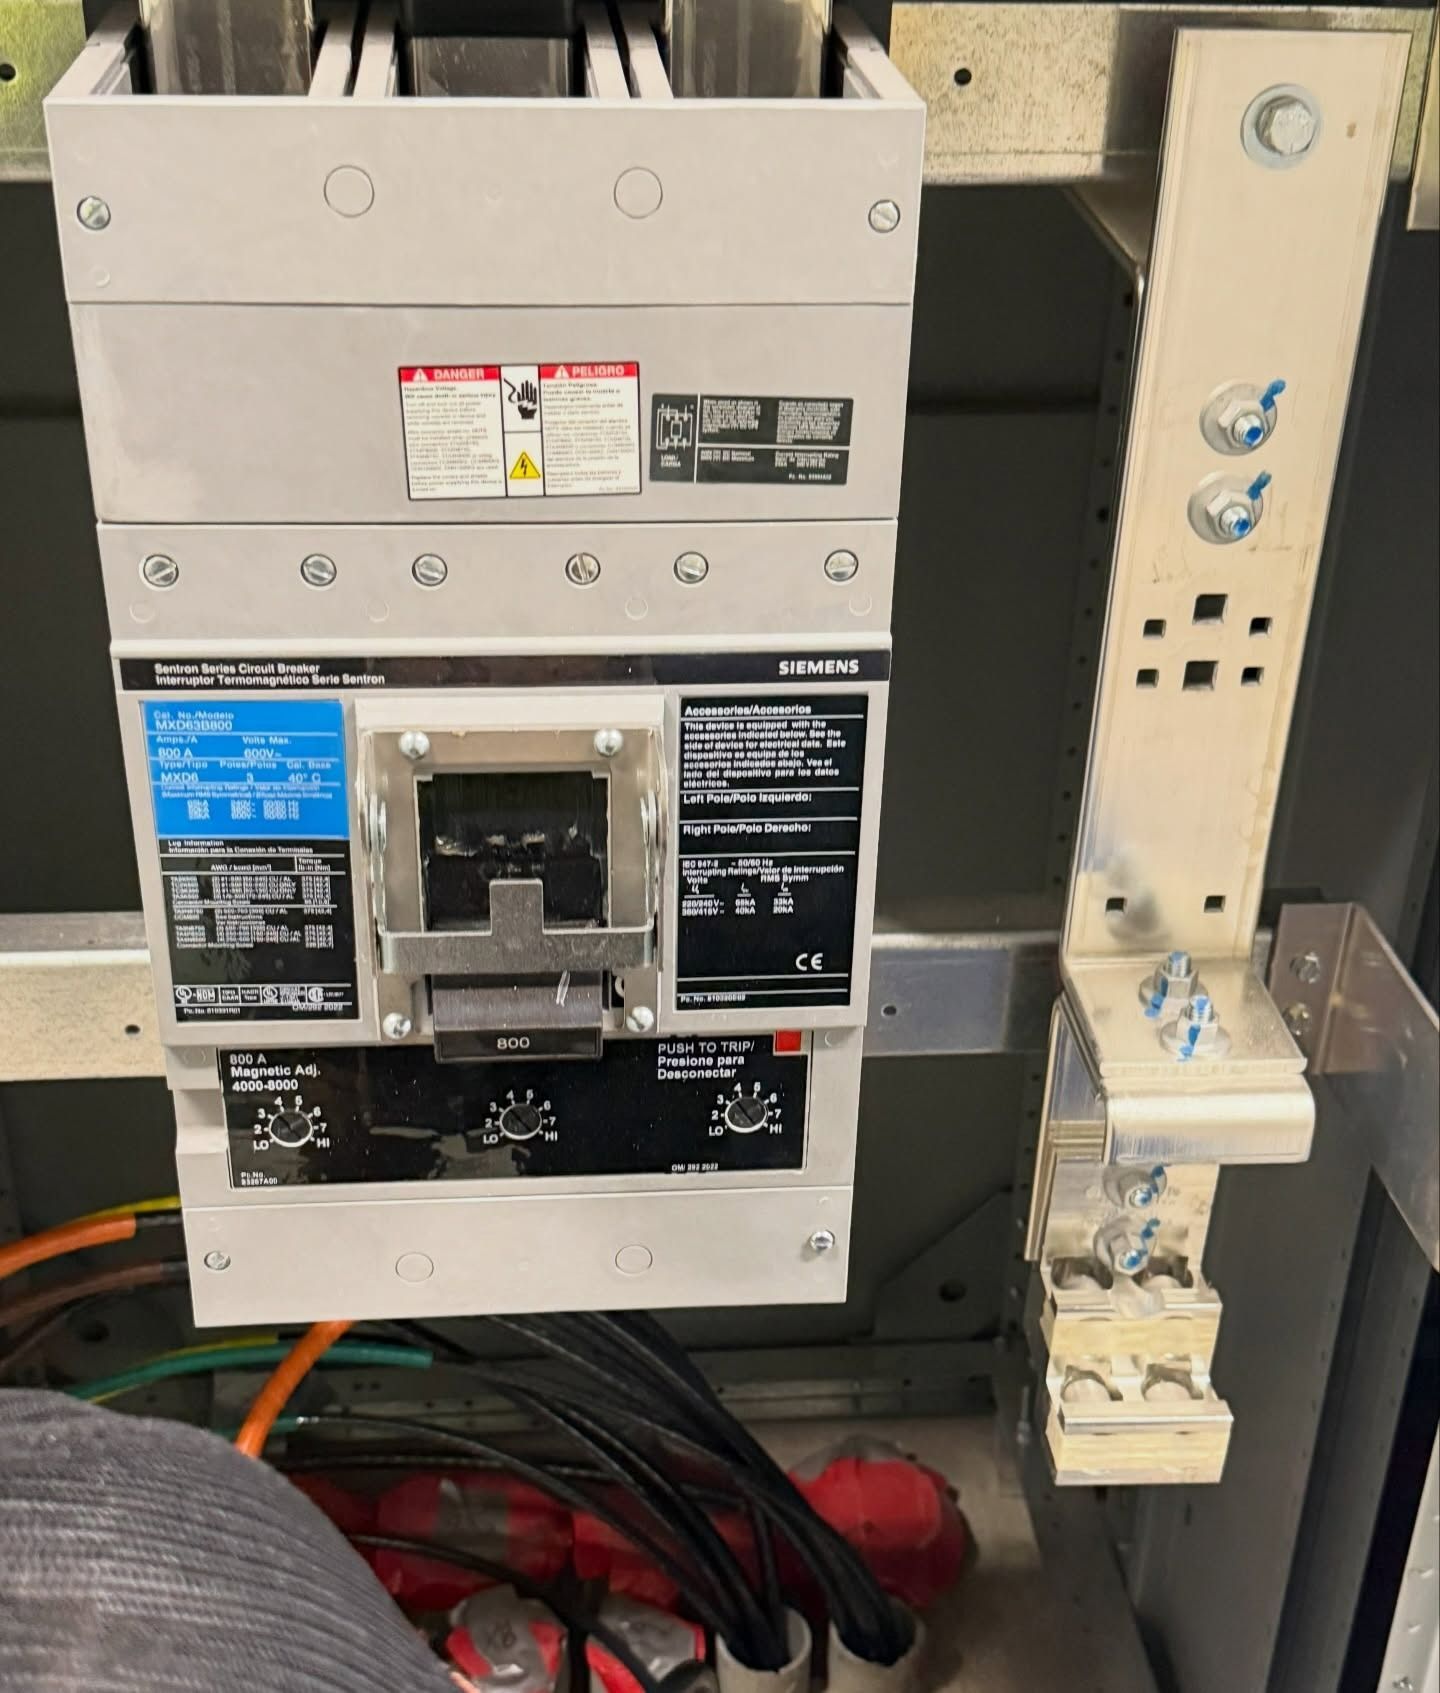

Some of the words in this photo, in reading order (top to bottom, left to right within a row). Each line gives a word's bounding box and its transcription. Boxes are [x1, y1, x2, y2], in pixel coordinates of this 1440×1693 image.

[433, 368, 484, 381] DANGER
[572, 364, 624, 378] PELIGRO
[154, 663, 199, 674] Sentron
[239, 662, 275, 674] Circuit
[278, 662, 320, 674] Breaker
[778, 659, 859, 675] SIEMENS
[156, 674, 215, 687] Interruptor
[217, 674, 309, 687] Termomagnético
[342, 674, 385, 685] Sentron
[684, 722, 704, 731] This
[791, 720, 810, 729] with
[812, 720, 826, 729] the
[827, 729, 841, 738] the
[745, 740, 758, 749] for
[161, 772, 199, 783] MXD6
[246, 773, 254, 783] 3
[683, 794, 705, 804] Left
[706, 792, 757, 804] Pole/Polo
[759, 792, 812, 805] Izquierdo:
[683, 824, 711, 837] Right
[795, 953, 823, 971] CE
[497, 1037, 530, 1049] 800
[658, 1043, 694, 1054] PUSH
[699, 1042, 717, 1053] TO
[721, 1040, 755, 1052] TRIP/
[229, 1054, 253, 1065] 800
[257, 1054, 267, 1065] A
[658, 1056, 714, 1067] Presione
[717, 1056, 745, 1068] para
[231, 1065, 291, 1079] Magnetic
[295, 1064, 321, 1078] Adj.
[657, 1067, 737, 1080] Desconectar
[232, 1079, 298, 1092] 4000-8000
[734, 1083, 742, 1092] 4
[754, 1082, 761, 1091] 5
[506, 1089, 514, 1100] 4
[526, 1089, 534, 1099] 5
[717, 1094, 724, 1105] 3
[770, 1093, 777, 1103] 6
[274, 1096, 283, 1106] 4
[295, 1095, 303, 1105] 5
[313, 1106, 322, 1117] 6
[489, 1102, 497, 1112] 3
[544, 1101, 551, 1111] 6
[258, 1108, 266, 1119] 3
[712, 1110, 719, 1120] 2
[774, 1109, 782, 1119] 7
[485, 1118, 493, 1128] 2
[549, 1116, 556, 1126] 7
[254, 1124, 262, 1135] 2
[320, 1123, 327, 1132] 7
[708, 1126, 724, 1136] LO
[769, 1123, 782, 1134] HI
[483, 1134, 498, 1144] LO
[545, 1131, 558, 1141] HI
[253, 1140, 269, 1151] LO
[317, 1138, 330, 1148] HI
